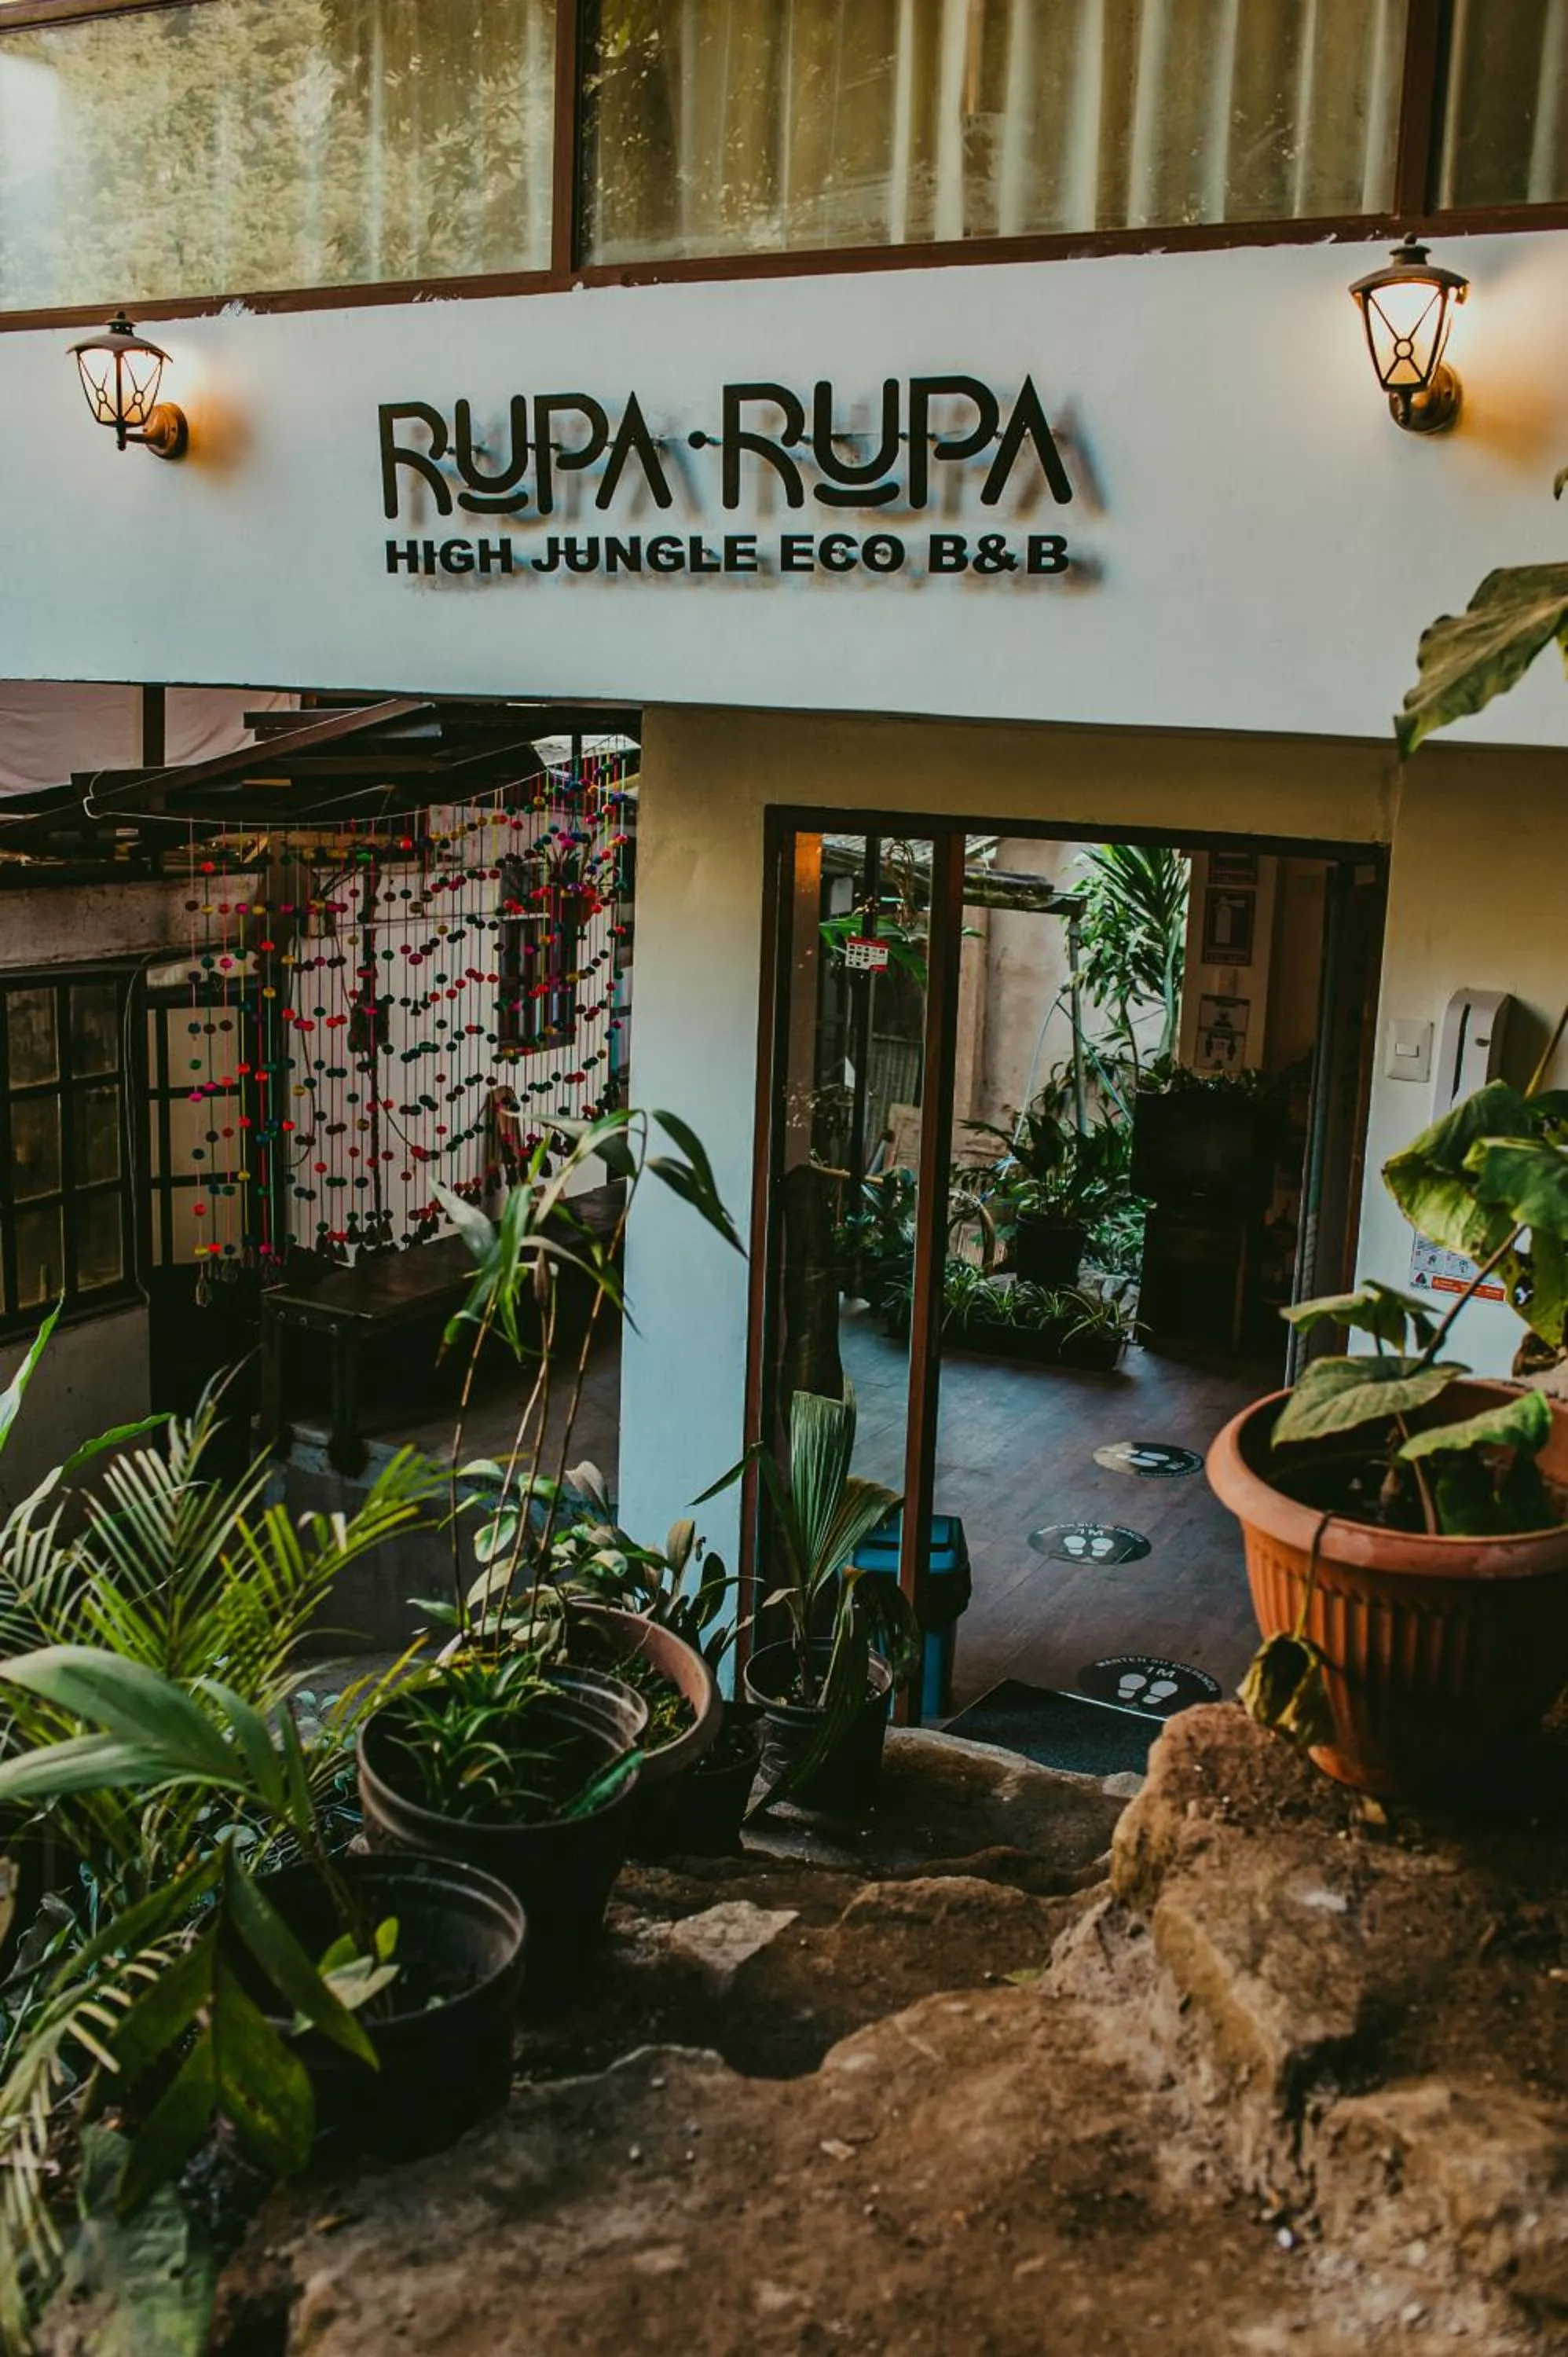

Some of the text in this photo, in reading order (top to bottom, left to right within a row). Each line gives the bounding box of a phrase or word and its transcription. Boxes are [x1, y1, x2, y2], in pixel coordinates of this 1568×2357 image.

[386, 534, 1070, 574] HIGH JUNGLE ECO B&B
